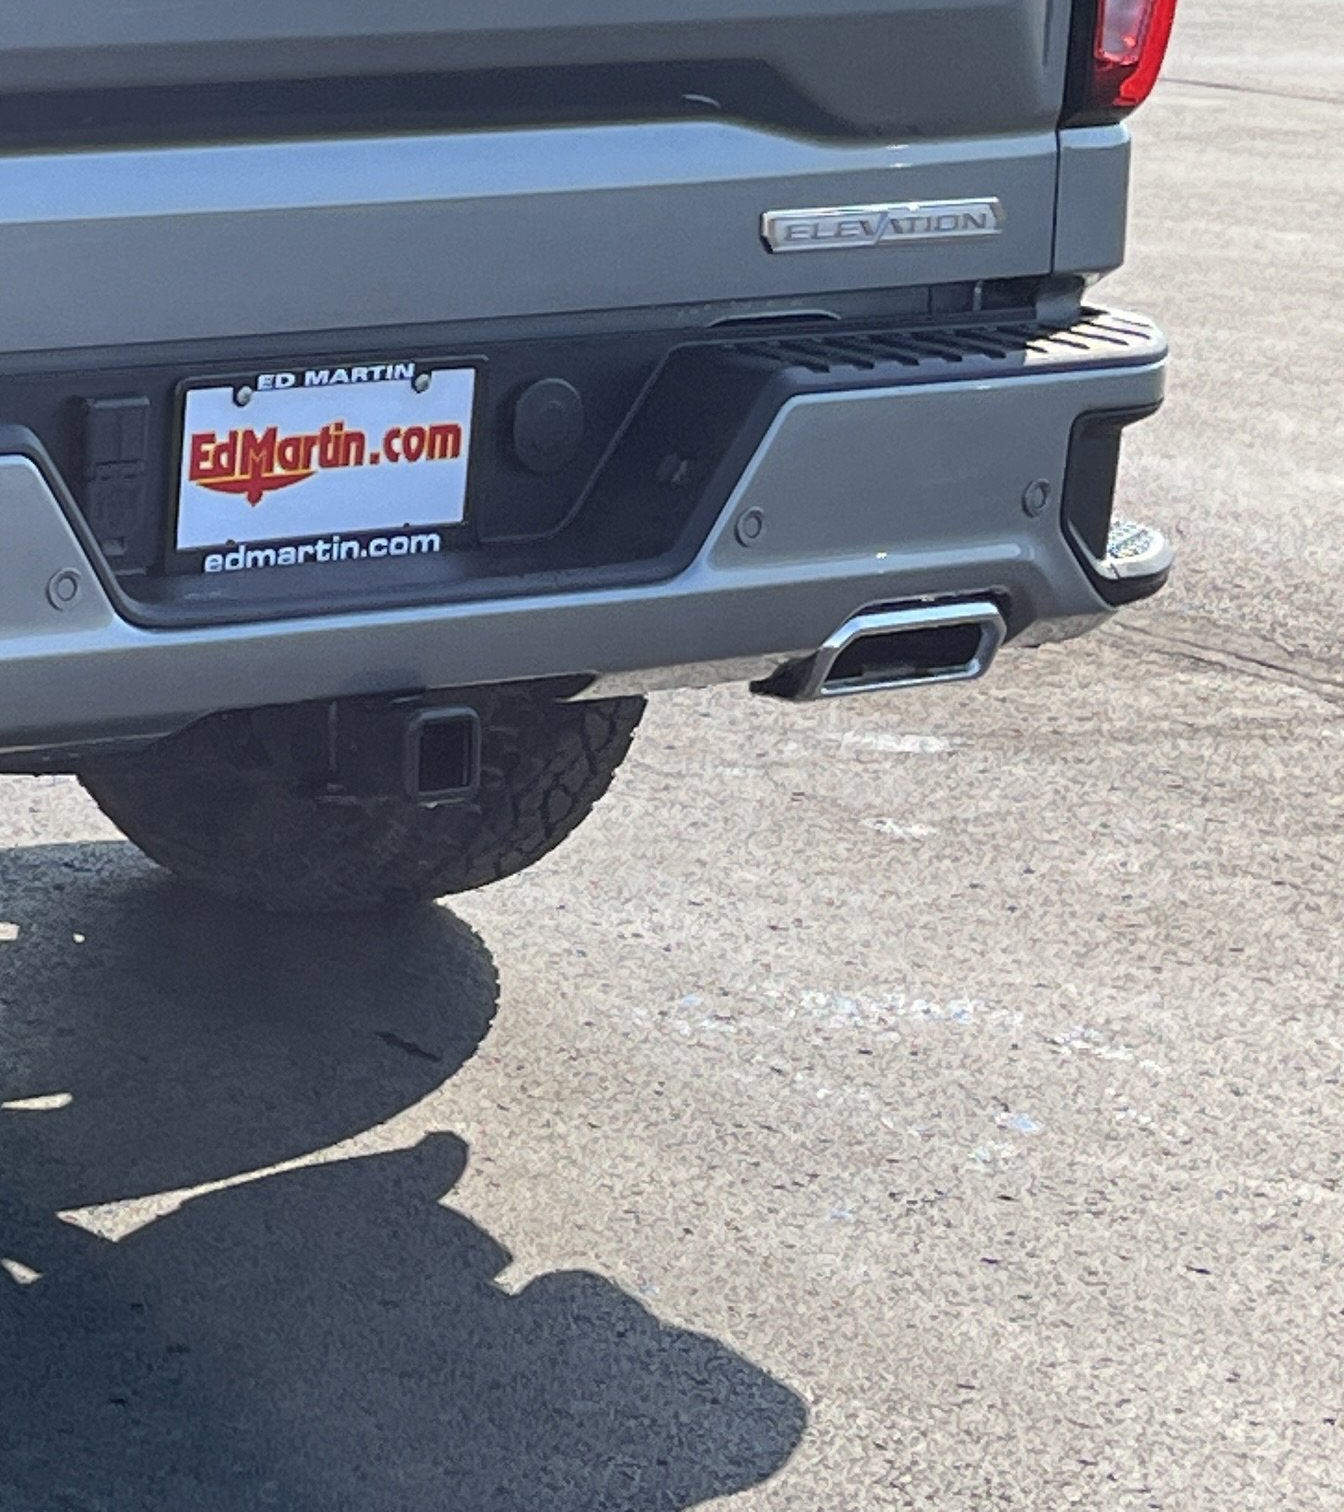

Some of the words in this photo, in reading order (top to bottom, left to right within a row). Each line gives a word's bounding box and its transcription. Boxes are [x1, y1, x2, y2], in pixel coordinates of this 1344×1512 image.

[783, 211, 987, 242] ELEVATION
[256, 373, 296, 390] ED
[303, 363, 416, 387] MARTIN
[189, 420, 462, 481] EdMartin.com
[204, 532, 441, 573] edmartin.com
